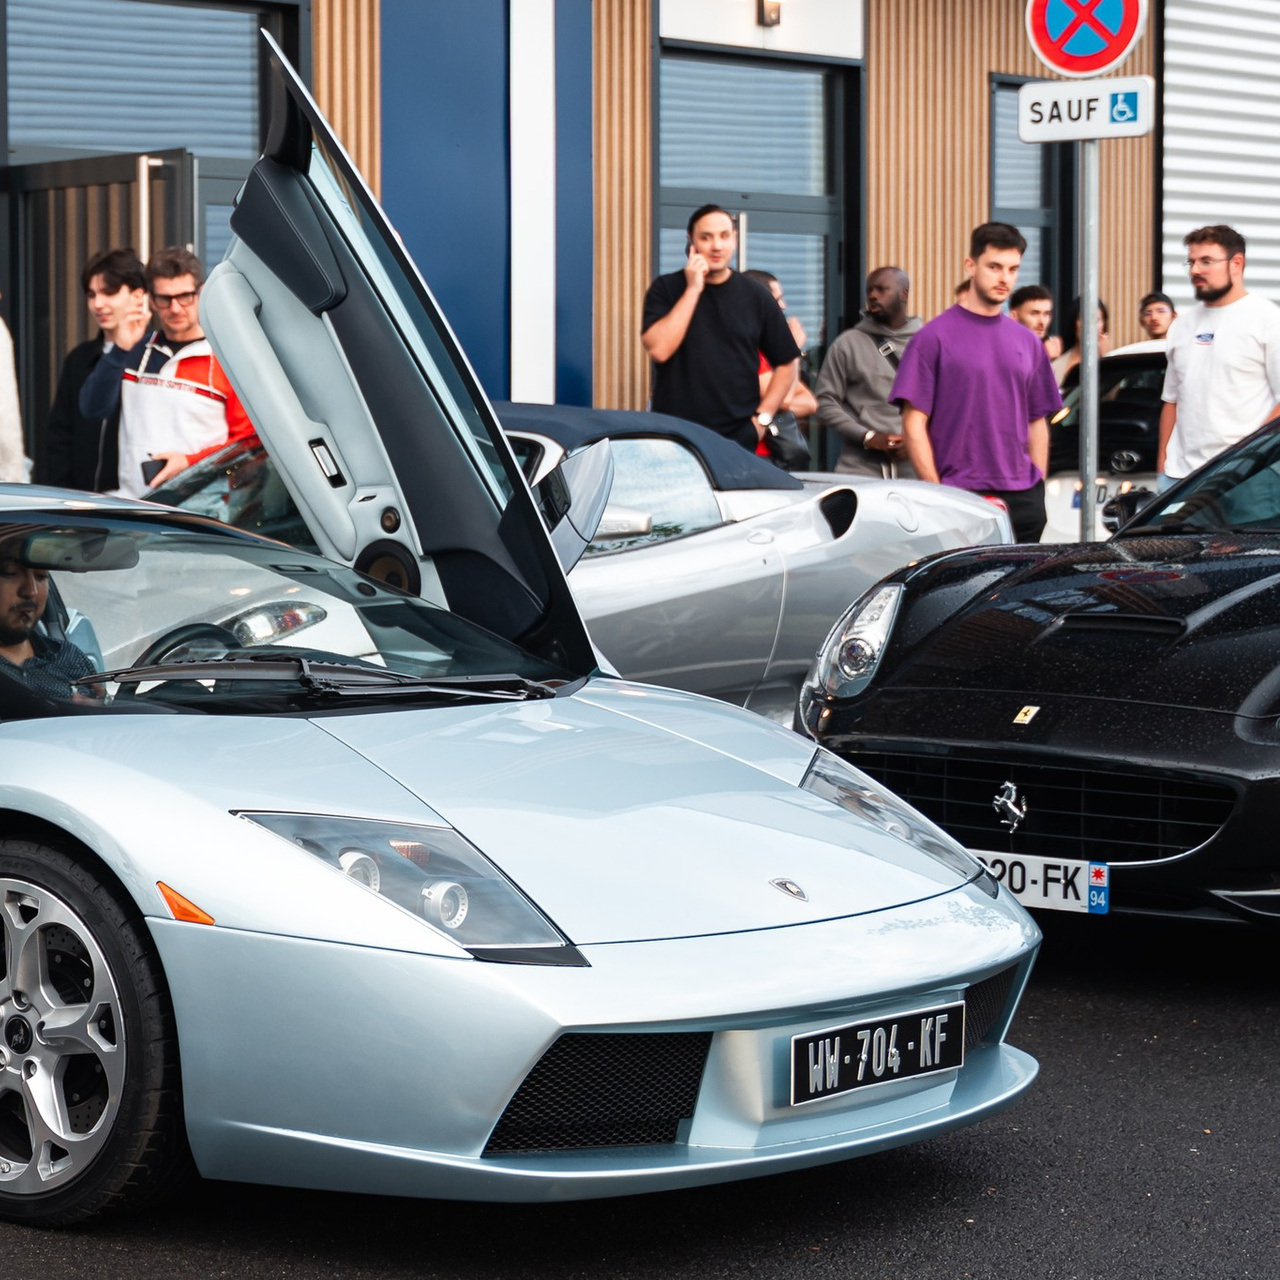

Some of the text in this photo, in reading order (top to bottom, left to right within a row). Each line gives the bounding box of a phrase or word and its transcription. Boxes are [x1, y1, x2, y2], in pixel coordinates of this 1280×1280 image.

[1030, 98, 1099, 124] SAUF
[976, 856, 1082, 901] 20-FK
[1090, 890, 1106, 907] 94
[808, 1013, 949, 1094] WW-704-KF
